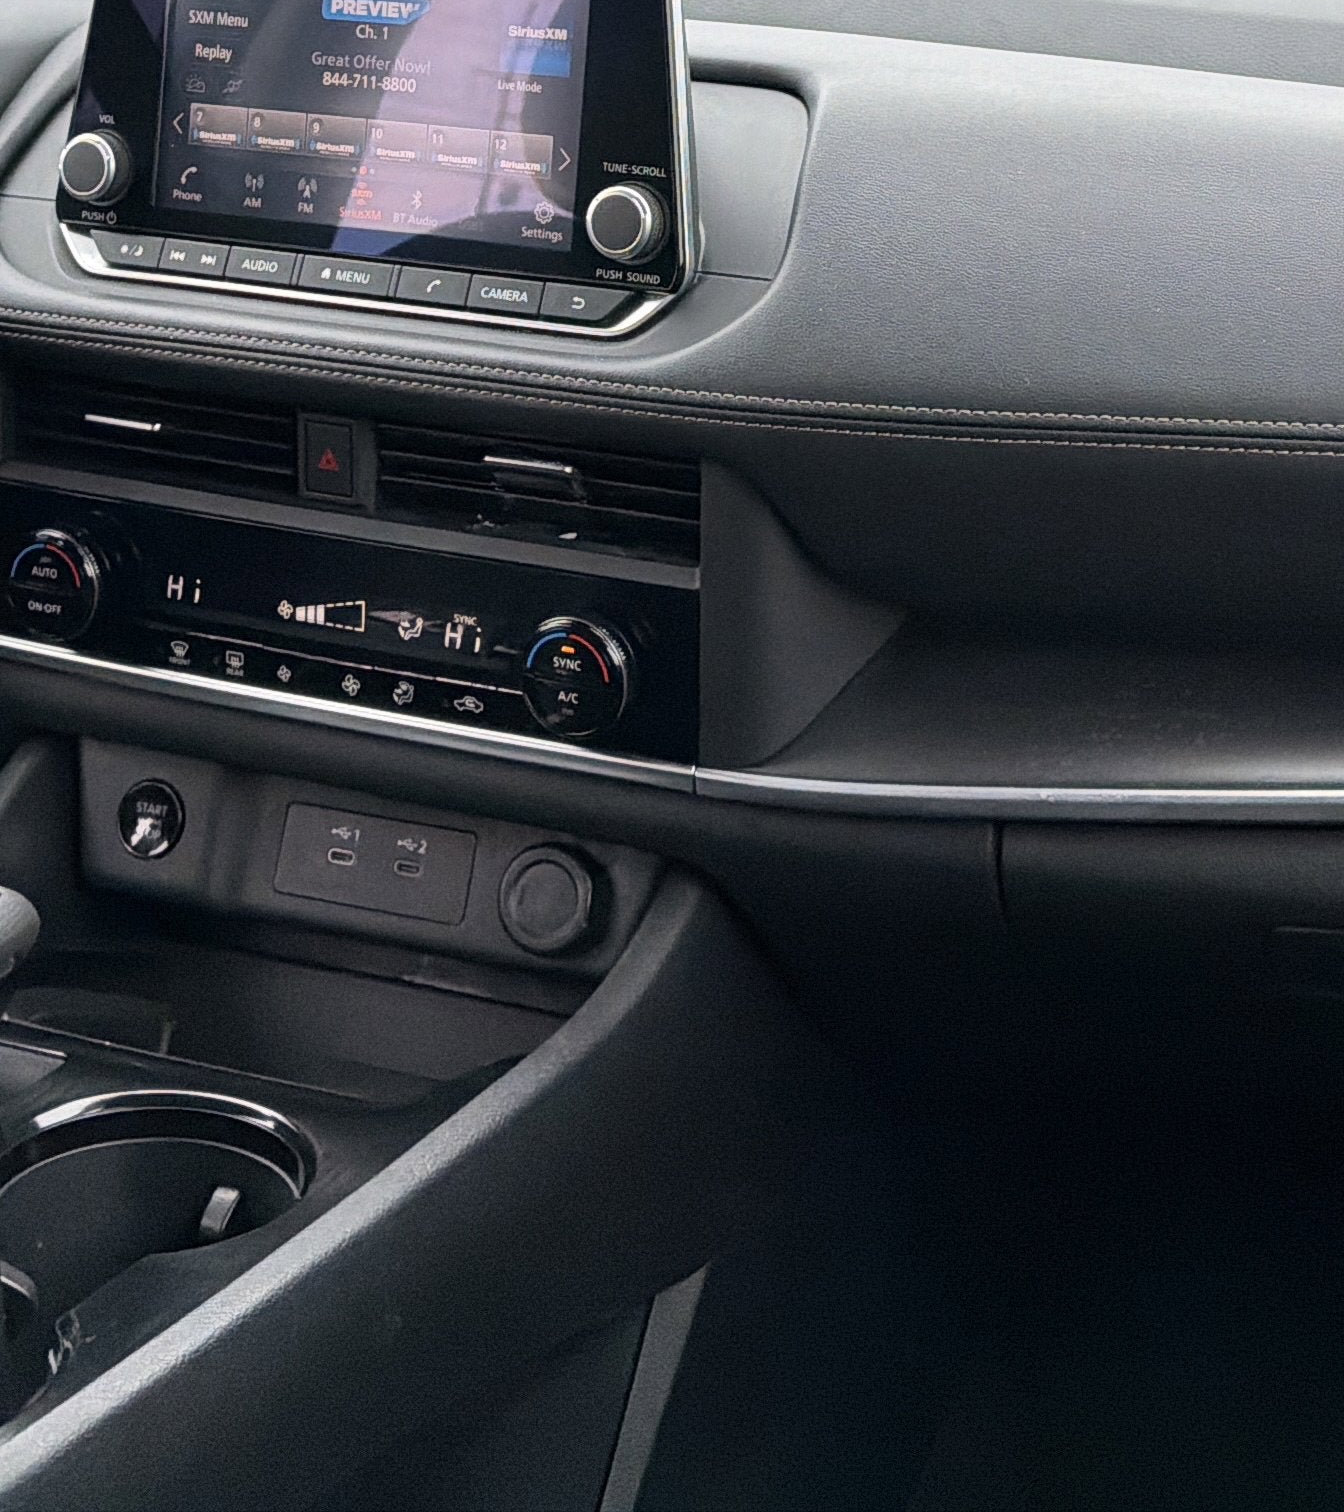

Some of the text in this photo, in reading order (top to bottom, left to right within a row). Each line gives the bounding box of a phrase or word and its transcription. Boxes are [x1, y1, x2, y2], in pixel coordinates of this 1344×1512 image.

[189, 9, 249, 28] SXM Menu
[356, 25, 389, 40] Ch. 1
[195, 43, 233, 63] Replay
[311, 52, 431, 75] Great Offer Now!
[322, 71, 417, 94] 844-711-8800
[497, 79, 543, 94] Live Mode
[99, 114, 115, 125] VOL
[196, 111, 203, 122] 7
[253, 116, 261, 128] 8
[312, 122, 320, 133] 9
[371, 127, 384, 139] 10
[432, 133, 444, 145] 11
[495, 139, 507, 151] 12
[602, 162, 667, 178] TUNE-SCROLL
[172, 188, 202, 202] Phone
[244, 198, 261, 208] AM
[298, 202, 313, 213] FM
[81, 210, 105, 222] PUSH
[339, 206, 383, 220] SiriusXM
[393, 212, 438, 227] BT Audio
[521, 226, 563, 243] Settings
[241, 258, 278, 272] AUDIO
[335, 270, 371, 284] MENU
[596, 268, 661, 285] PUSH SOUND
[481, 287, 528, 303] CAMERA
[31, 565, 57, 579] AUTO
[166, 574, 202, 604] Hi
[453, 614, 478, 626] SYNC
[444, 622, 482, 653] Hi
[553, 656, 582, 672] SYNC
[558, 691, 579, 704] A/C
[136, 801, 168, 817] START
[354, 828, 361, 841] 1
[418, 839, 427, 854] 2
